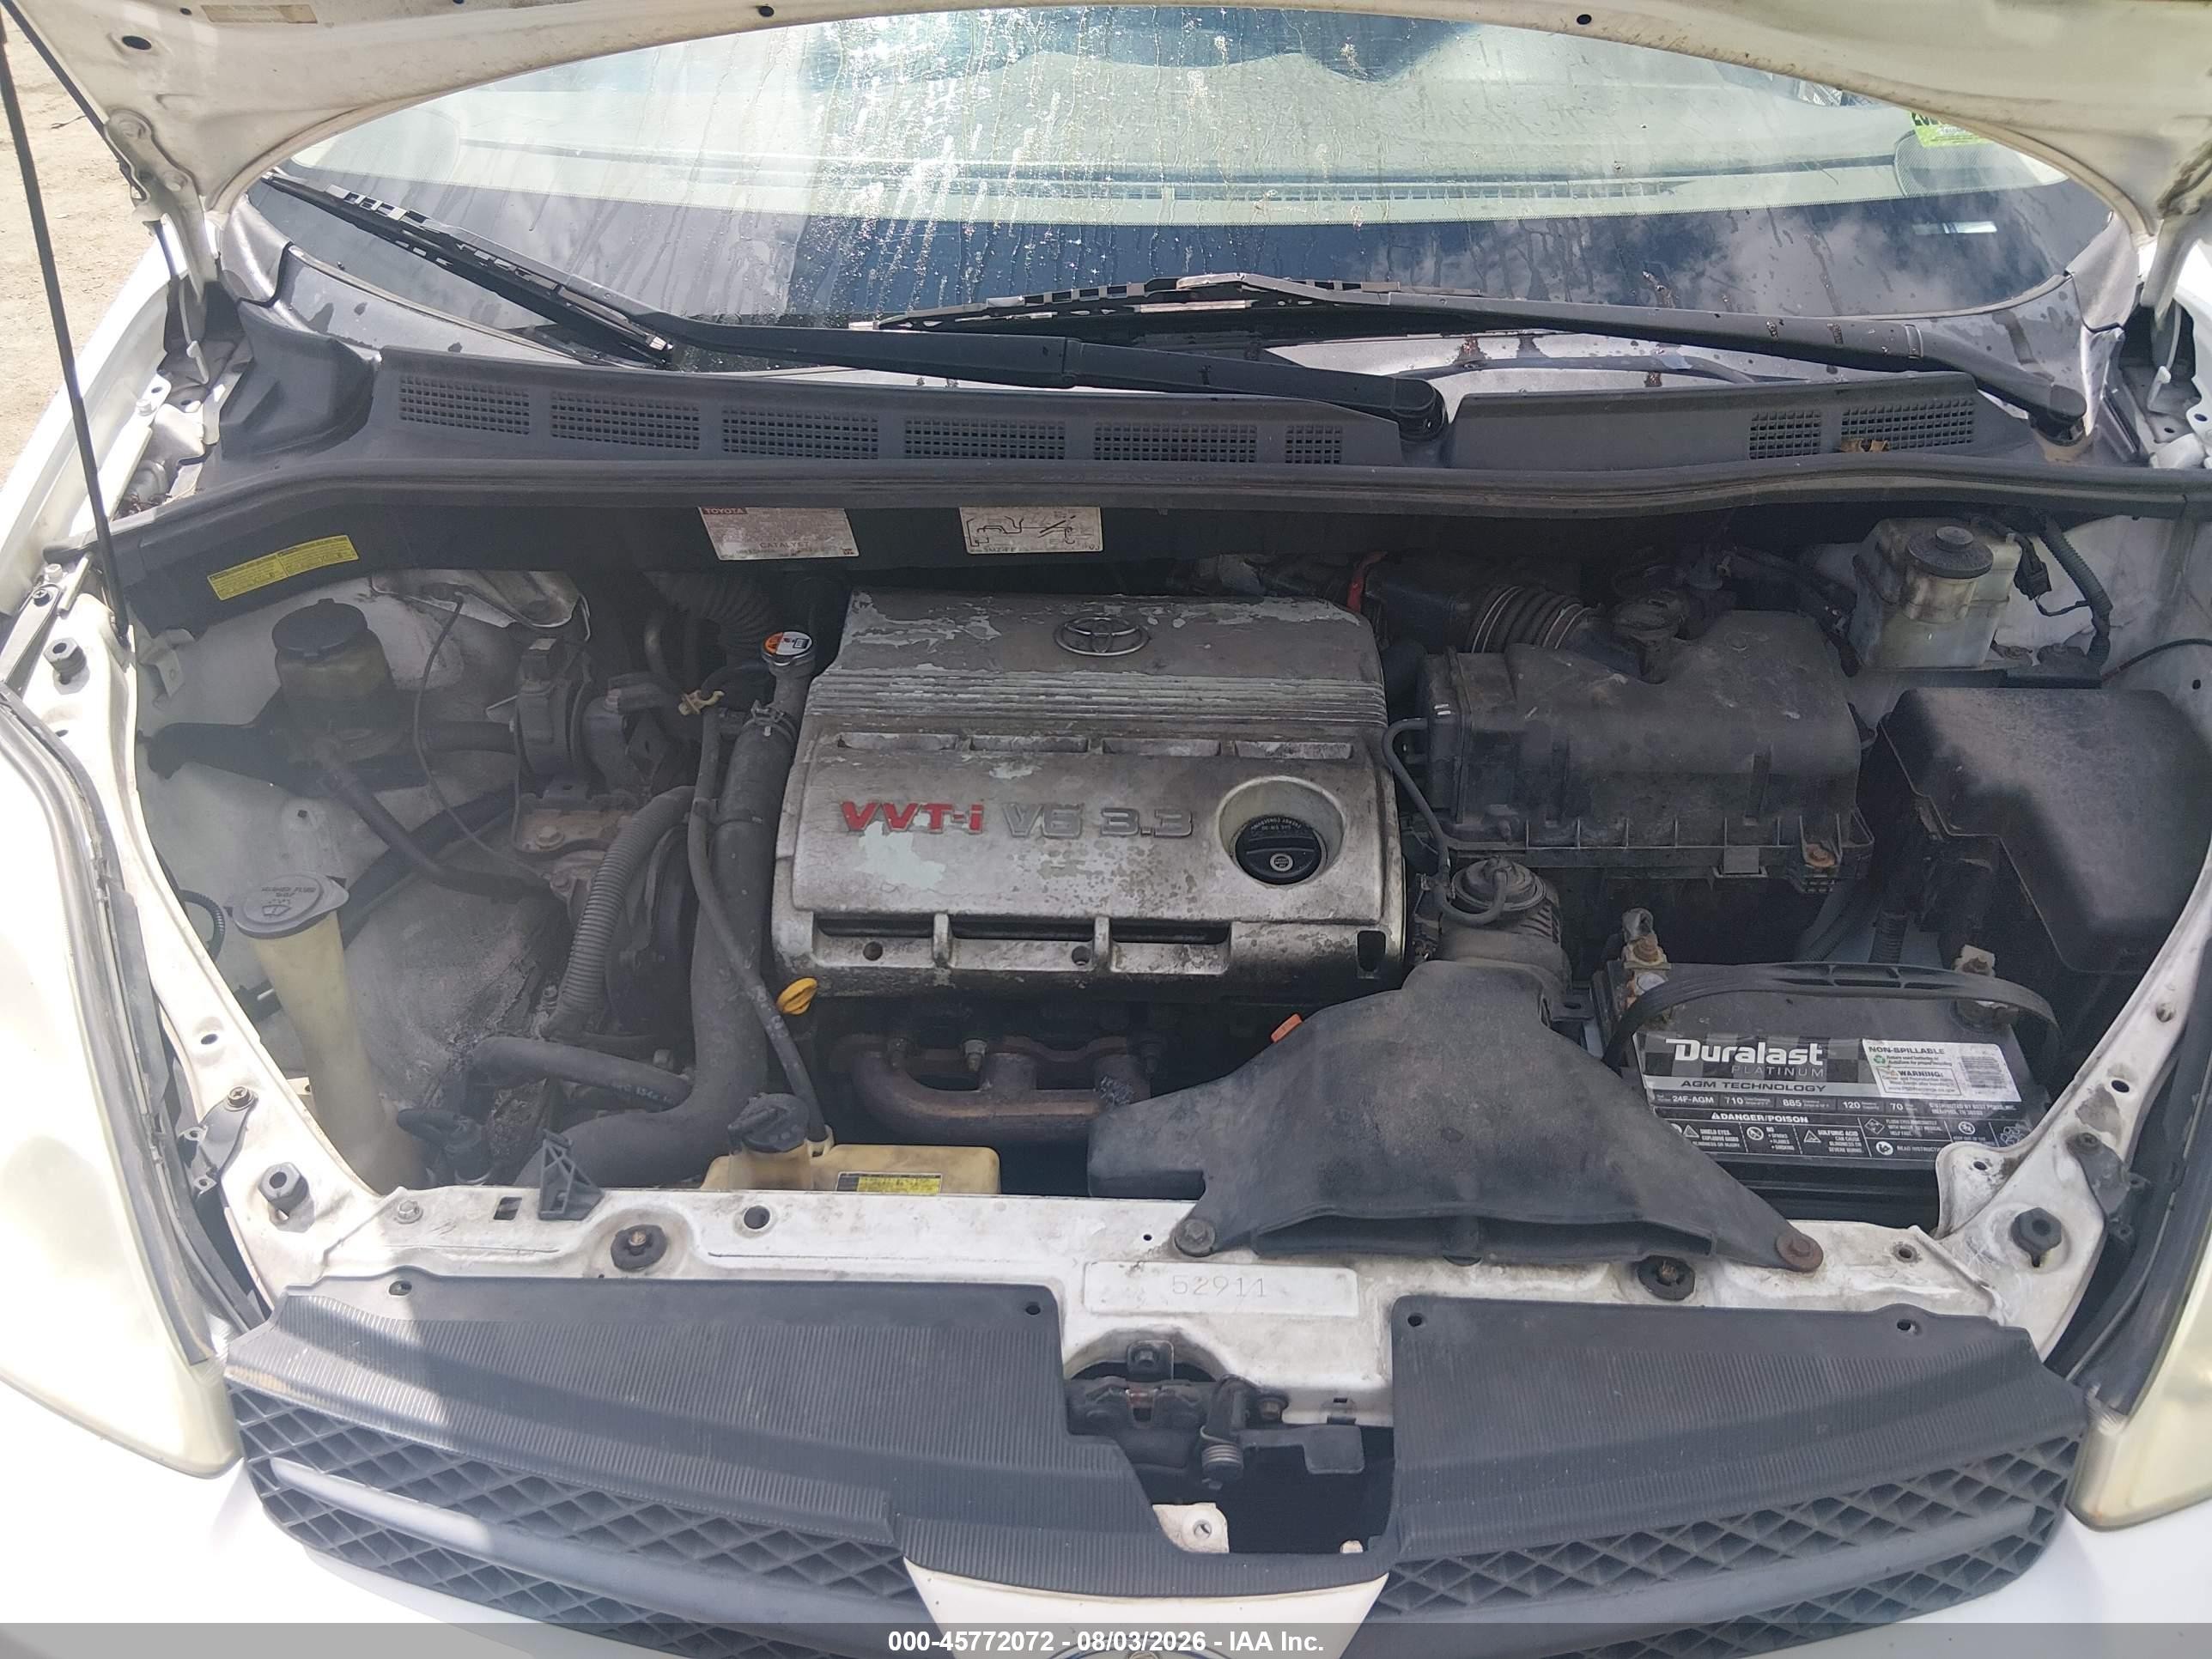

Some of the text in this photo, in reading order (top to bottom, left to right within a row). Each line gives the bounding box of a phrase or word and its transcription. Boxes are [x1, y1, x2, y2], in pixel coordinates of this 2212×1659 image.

[841, 800, 1194, 838] VVT-i V6 3.3
[1666, 1038, 1824, 1066] Duralast
[1869, 1046, 1945, 1054] NON-SPILLABLE
[1731, 1065, 1825, 1078] PLATINUM
[1680, 1080, 1827, 1093] AGM TECHNOLOGY
[1724, 1097, 1744, 1105] 710
[1783, 1098, 1802, 1107] 885
[1843, 1101, 1861, 1109] 120
[1720, 1113, 1809, 1123] DANGER/POISON
[1172, 1274, 1267, 1297] 52911
